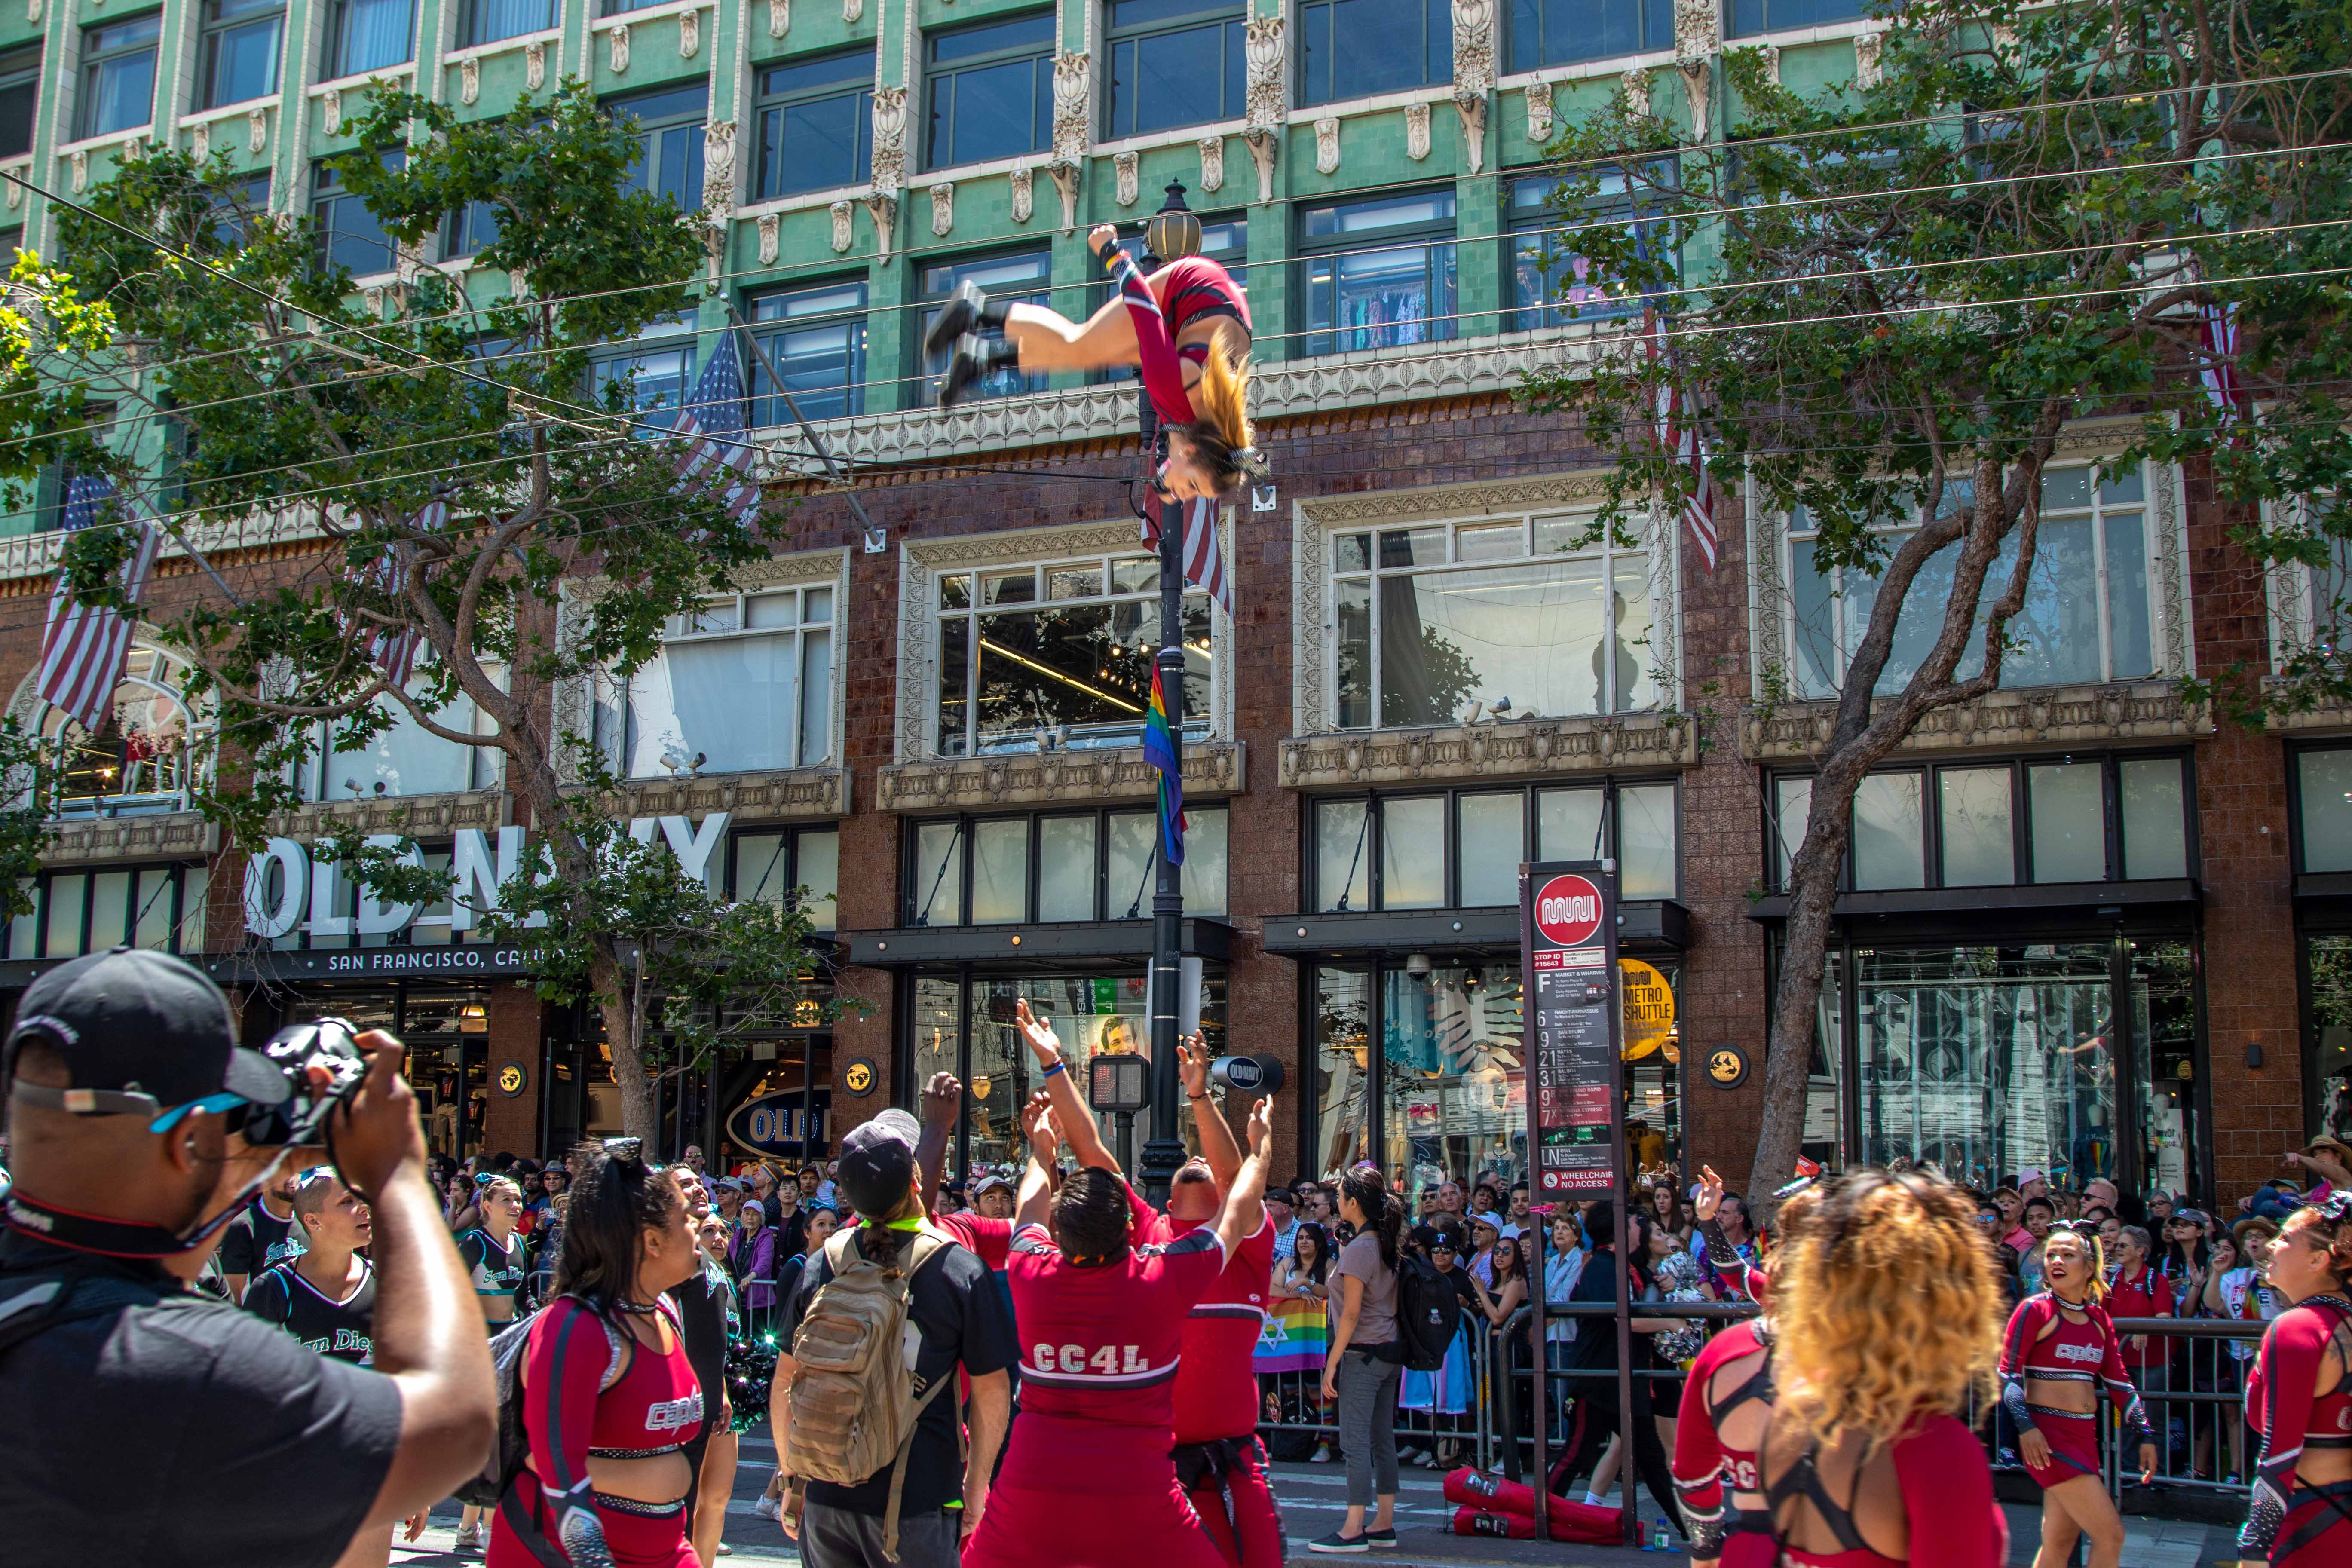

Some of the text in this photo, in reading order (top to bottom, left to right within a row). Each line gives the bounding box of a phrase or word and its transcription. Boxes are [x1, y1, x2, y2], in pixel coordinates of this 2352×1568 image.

[243, 834, 426, 938] OLD
[1541, 895, 1596, 925] MUNI
[329, 955, 364, 970] SAN
[373, 952, 485, 969] FRANCISCO,
[1539, 974, 1551, 993] F
[1624, 987, 1662, 1004] METRO
[1538, 1011, 1546, 1027] 6
[1624, 1004, 1671, 1020] SHUTTLE
[1540, 1031, 1549, 1047] 9
[1540, 1050, 1556, 1067] 21
[1230, 1064, 1259, 1081] OLD NAVY
[1540, 1070, 1556, 1087] 31
[1542, 1109, 1557, 1126] 7X
[1541, 1148, 1559, 1166] LN
[1561, 1171, 1613, 1179] WHEELCHAIR
[482, 1270, 507, 1284] San
[292, 1328, 375, 1359] an Dieg
[1033, 1343, 1149, 1375] CC4L
